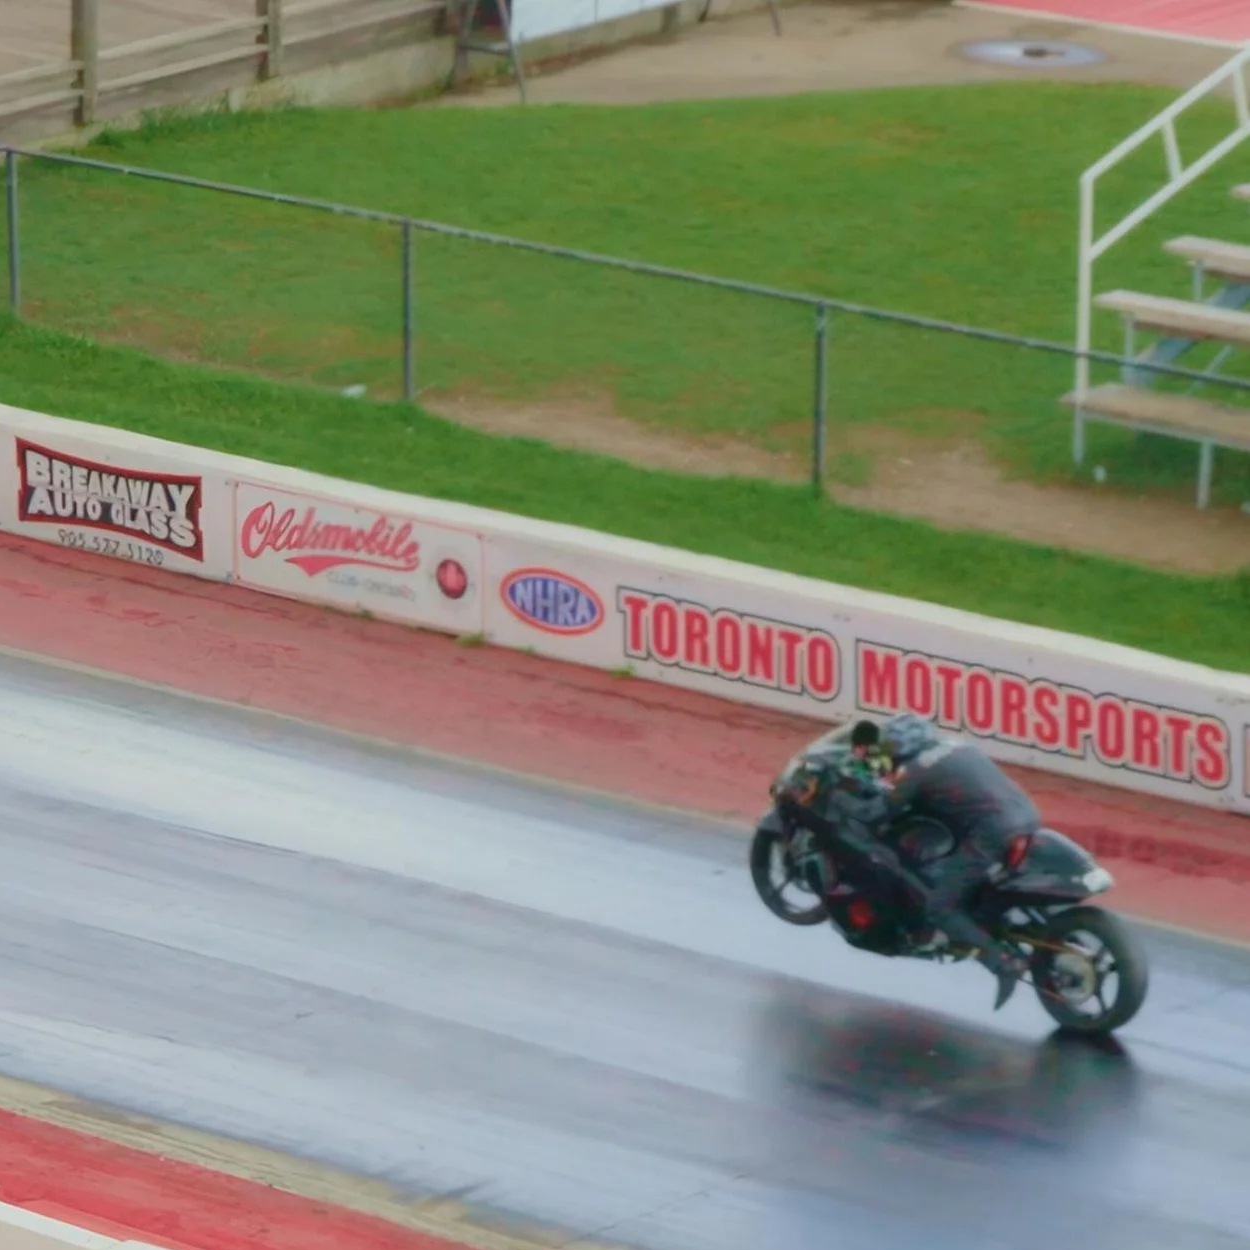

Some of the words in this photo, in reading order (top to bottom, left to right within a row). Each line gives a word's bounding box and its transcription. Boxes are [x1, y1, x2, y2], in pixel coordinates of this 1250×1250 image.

[25, 448, 197, 520] BREAKAWAY
[27, 486, 101, 521] AUTO
[111, 501, 197, 549] GLASS
[241, 500, 421, 564] Oldsmobile
[513, 576, 595, 629] NHRA
[619, 588, 840, 700] TORONTO
[858, 642, 1229, 788] MOTORSPORTS
